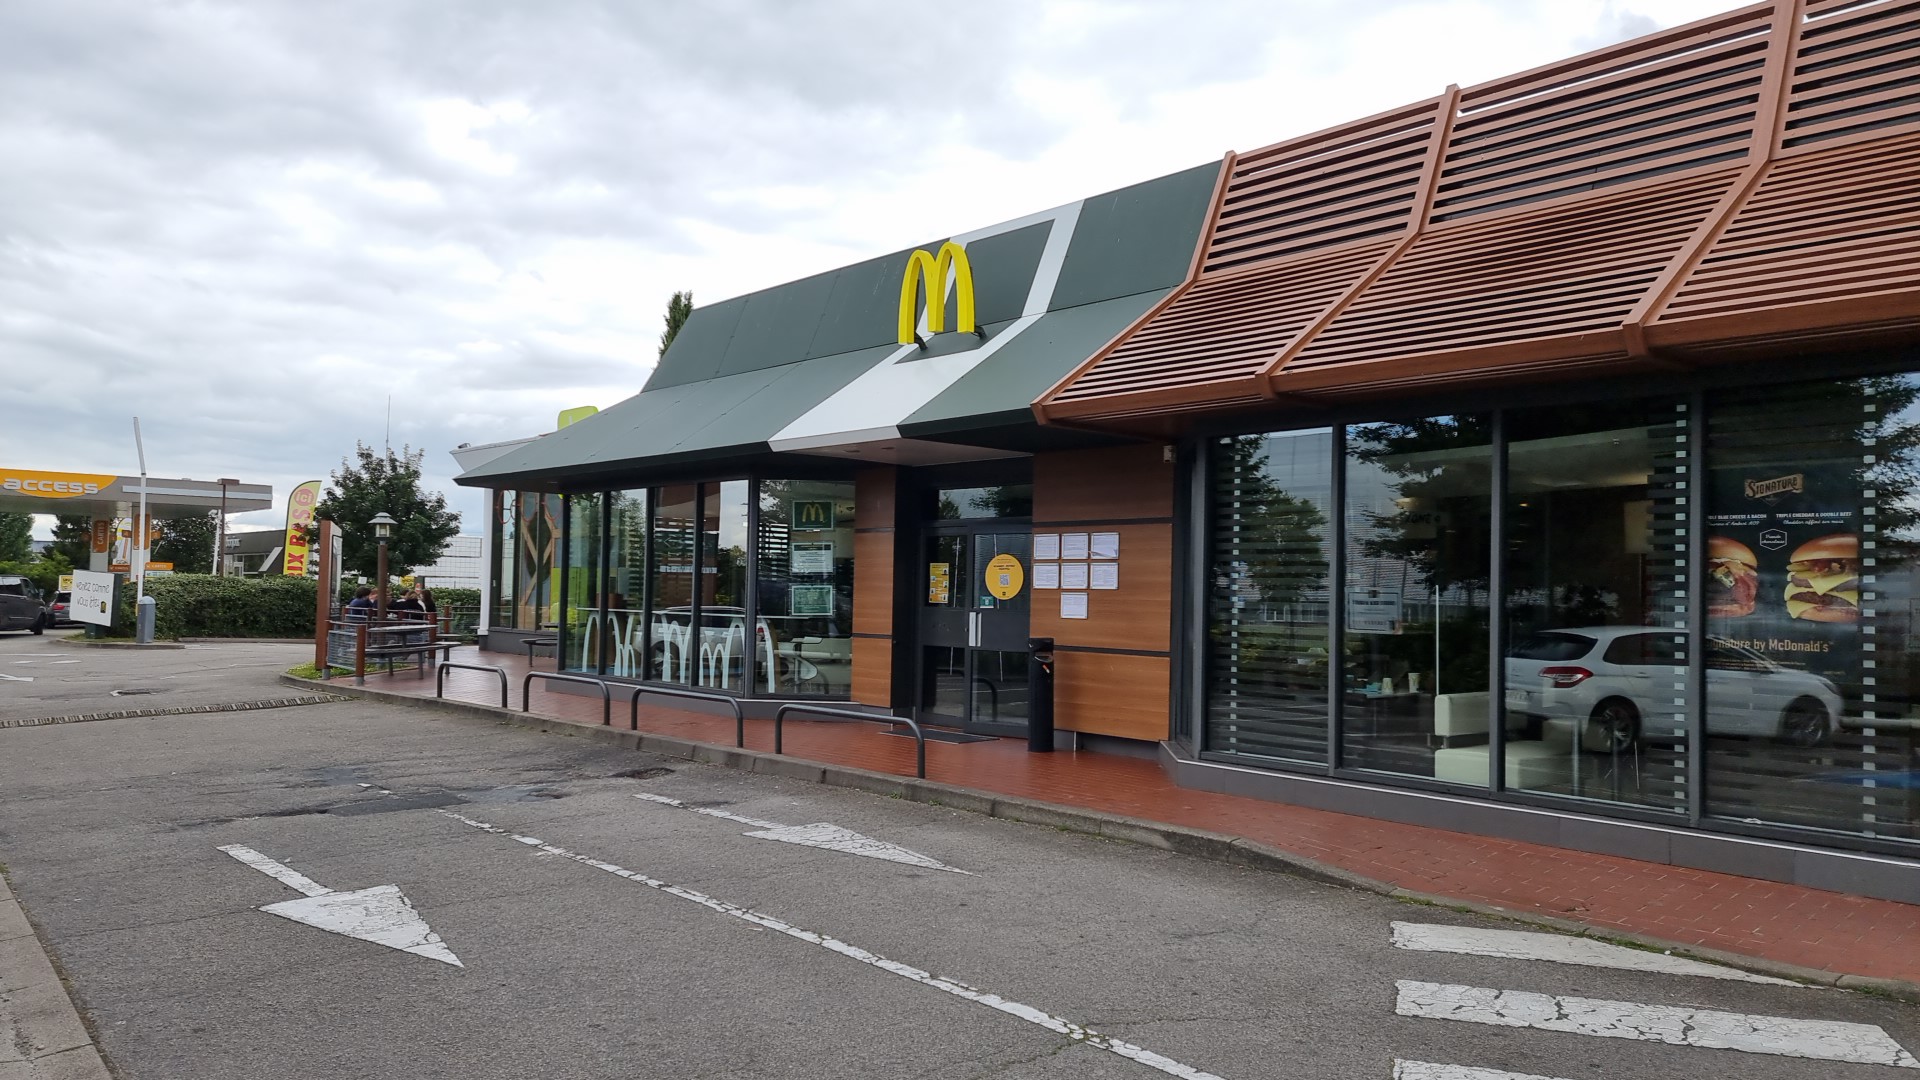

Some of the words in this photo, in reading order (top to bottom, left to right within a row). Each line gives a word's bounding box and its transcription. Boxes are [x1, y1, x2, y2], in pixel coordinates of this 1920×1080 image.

[3, 478, 99, 494] access
[1746, 476, 1800, 498] SIGNATURE
[296, 491, 313, 504] ici
[76, 581, 91, 592] venez
[92, 583, 110, 594] comme
[1753, 638, 1766, 652] by
